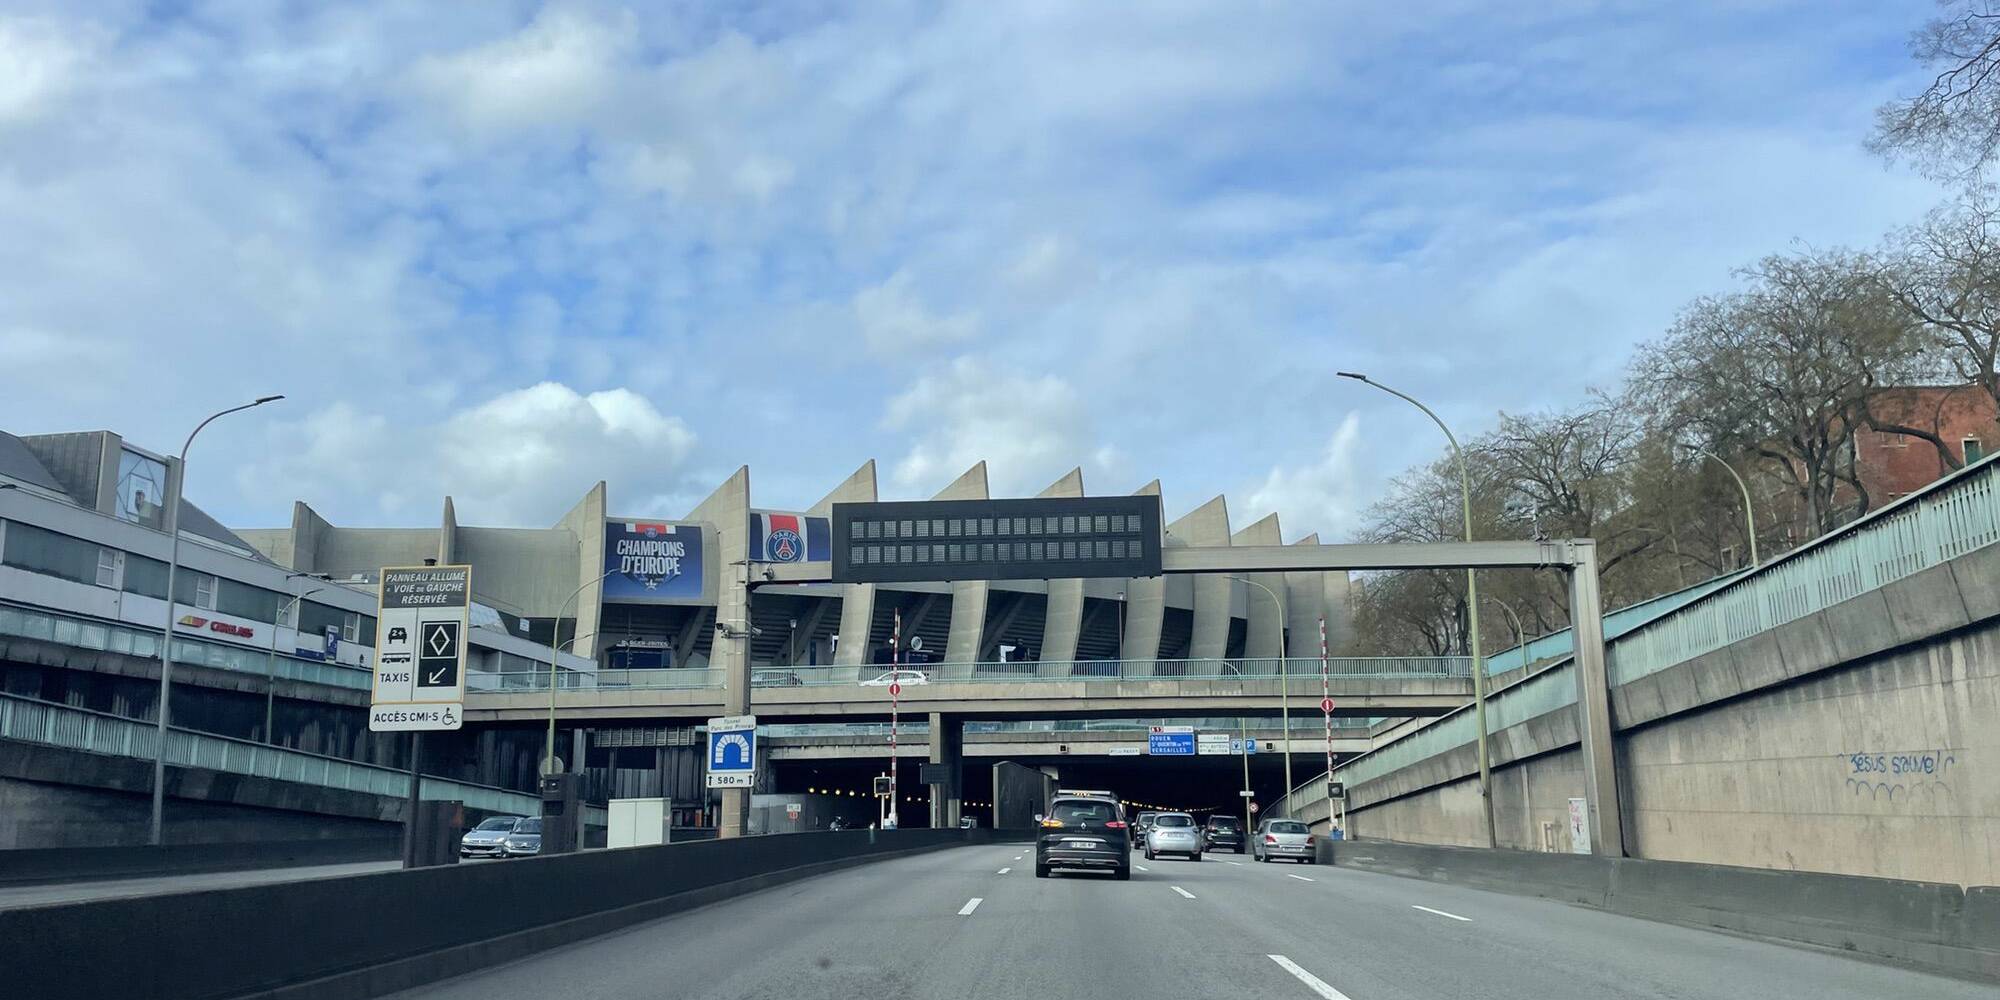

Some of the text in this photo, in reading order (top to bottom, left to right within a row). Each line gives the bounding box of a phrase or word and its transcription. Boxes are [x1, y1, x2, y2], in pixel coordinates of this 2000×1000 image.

[773, 531, 798, 541] PARIS
[617, 539, 685, 557] CHAMPIONS
[621, 556, 681, 575] D'EUROPE
[386, 571, 466, 582] PANNEAU ALLUMÉ
[394, 585, 415, 593] VOIE
[426, 583, 464, 592] GAUCHE
[401, 594, 448, 604] RÉSERVÉE
[380, 673, 410, 683] TAXIS
[374, 711, 439, 723] ACCÈS CMI-S
